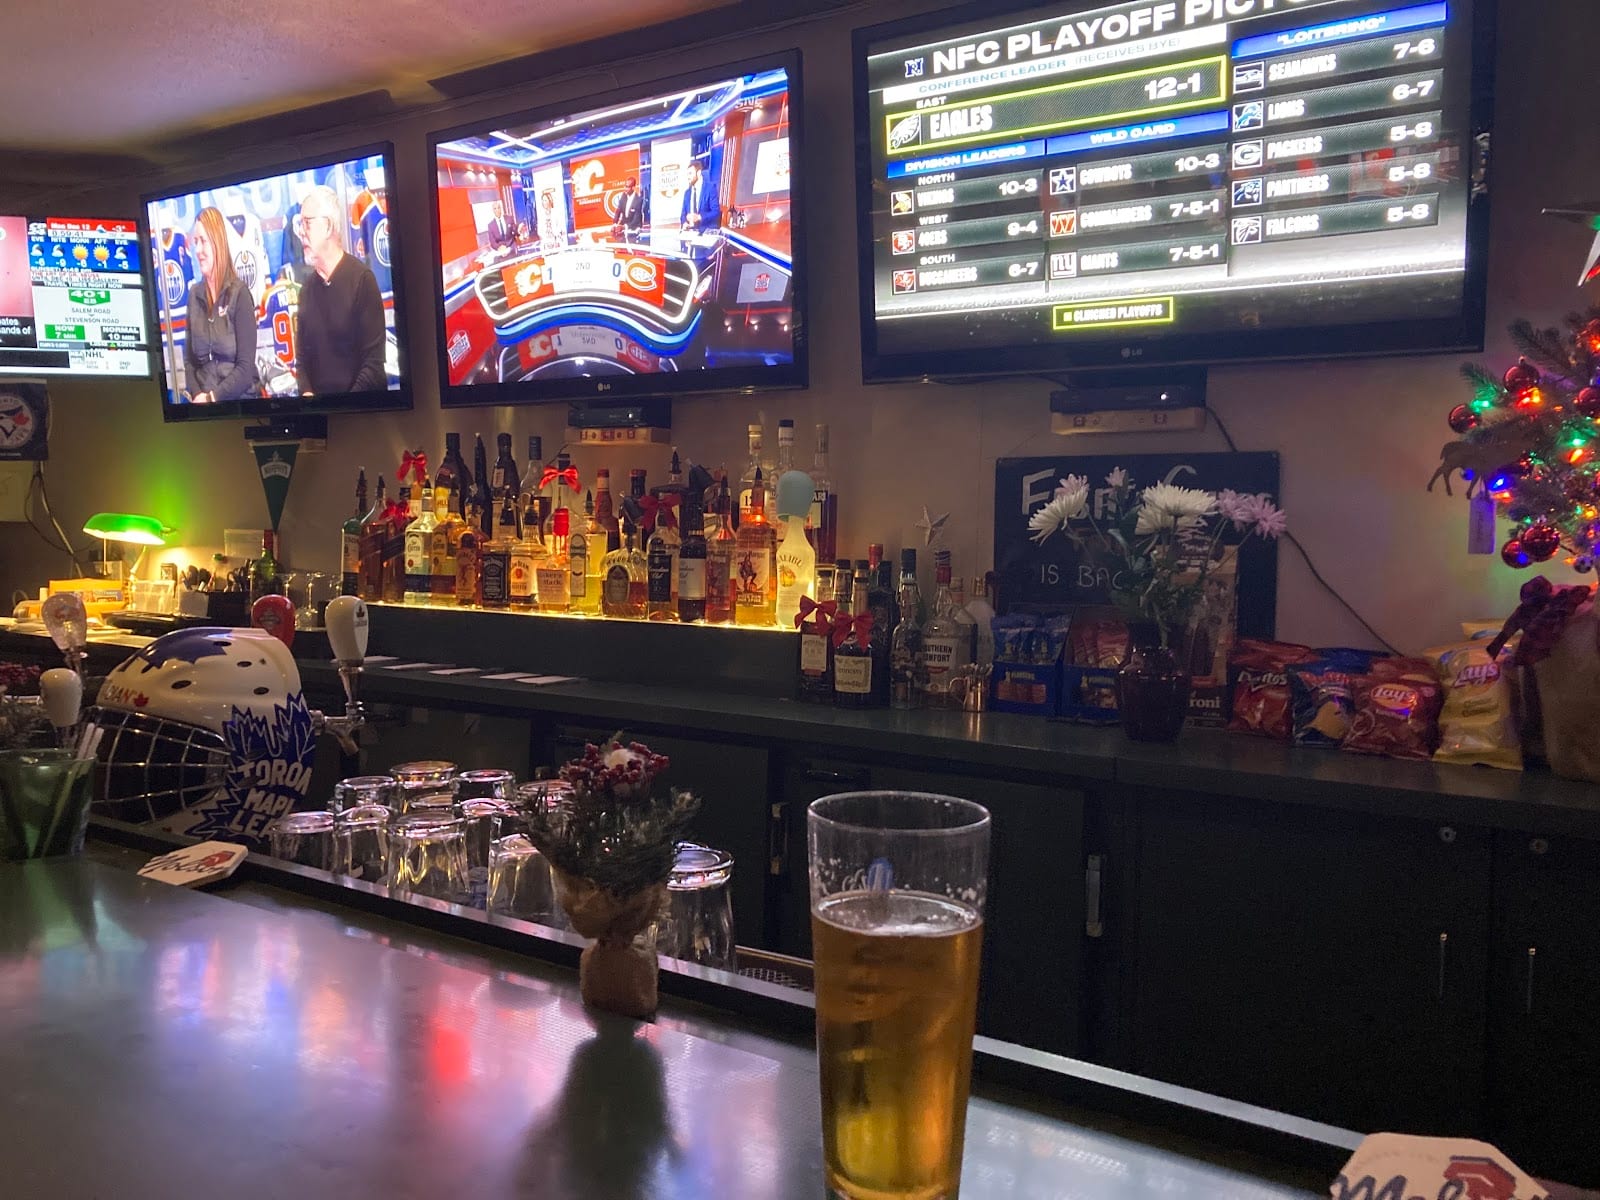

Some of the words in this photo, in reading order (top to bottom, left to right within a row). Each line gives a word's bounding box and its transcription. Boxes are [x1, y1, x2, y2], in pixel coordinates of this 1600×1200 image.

[933, 40, 1000, 73] NFC
[1008, 3, 1176, 60] PLAYOFF
[918, 69, 1008, 93] CONFERENCE
[1011, 59, 1066, 76] LEADER
[1145, 73, 1200, 100] 12-1
[916, 96, 947, 109] EAST
[930, 105, 993, 139] EAGLES
[905, 155, 961, 173] DIVISION
[1175, 154, 1220, 172] 10-3
[918, 173, 955, 185] NORTH
[999, 178, 1038, 195] 10-3
[919, 214, 948, 225] WEST
[1007, 220, 1037, 235] 9-4
[920, 254, 955, 265] SOUTH
[70, 290, 106, 299] 401
[1117, 304, 1162, 319] PLAYOFFS
[1040, 564, 1059, 584] IS
[1237, 669, 1289, 691] Doritos
